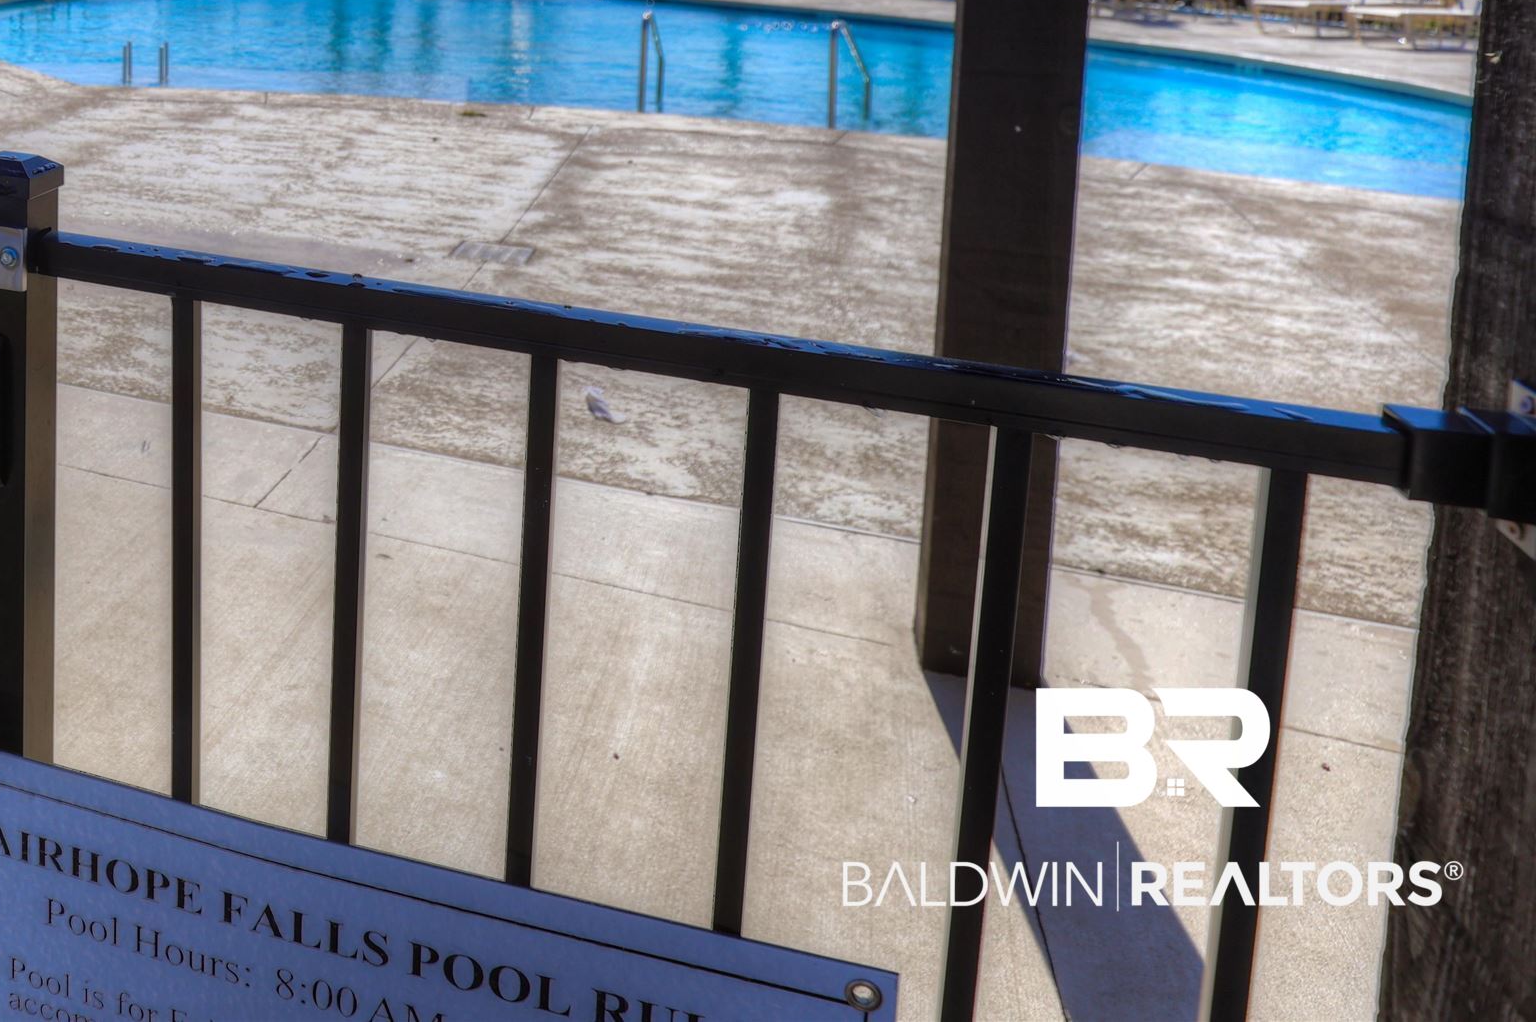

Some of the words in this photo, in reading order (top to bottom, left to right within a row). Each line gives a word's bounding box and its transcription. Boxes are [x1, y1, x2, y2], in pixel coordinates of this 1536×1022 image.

[9, 956, 72, 999] Pool
[82, 979, 105, 1011] is
[116, 991, 159, 1022] for
[44, 897, 118, 947] Pool
[136, 925, 251, 988] Hours:
[276, 968, 357, 1018] 8:00
[219, 889, 390, 967] FALLS
[407, 940, 571, 1018] POOL
[591, 987, 706, 1022] RU
